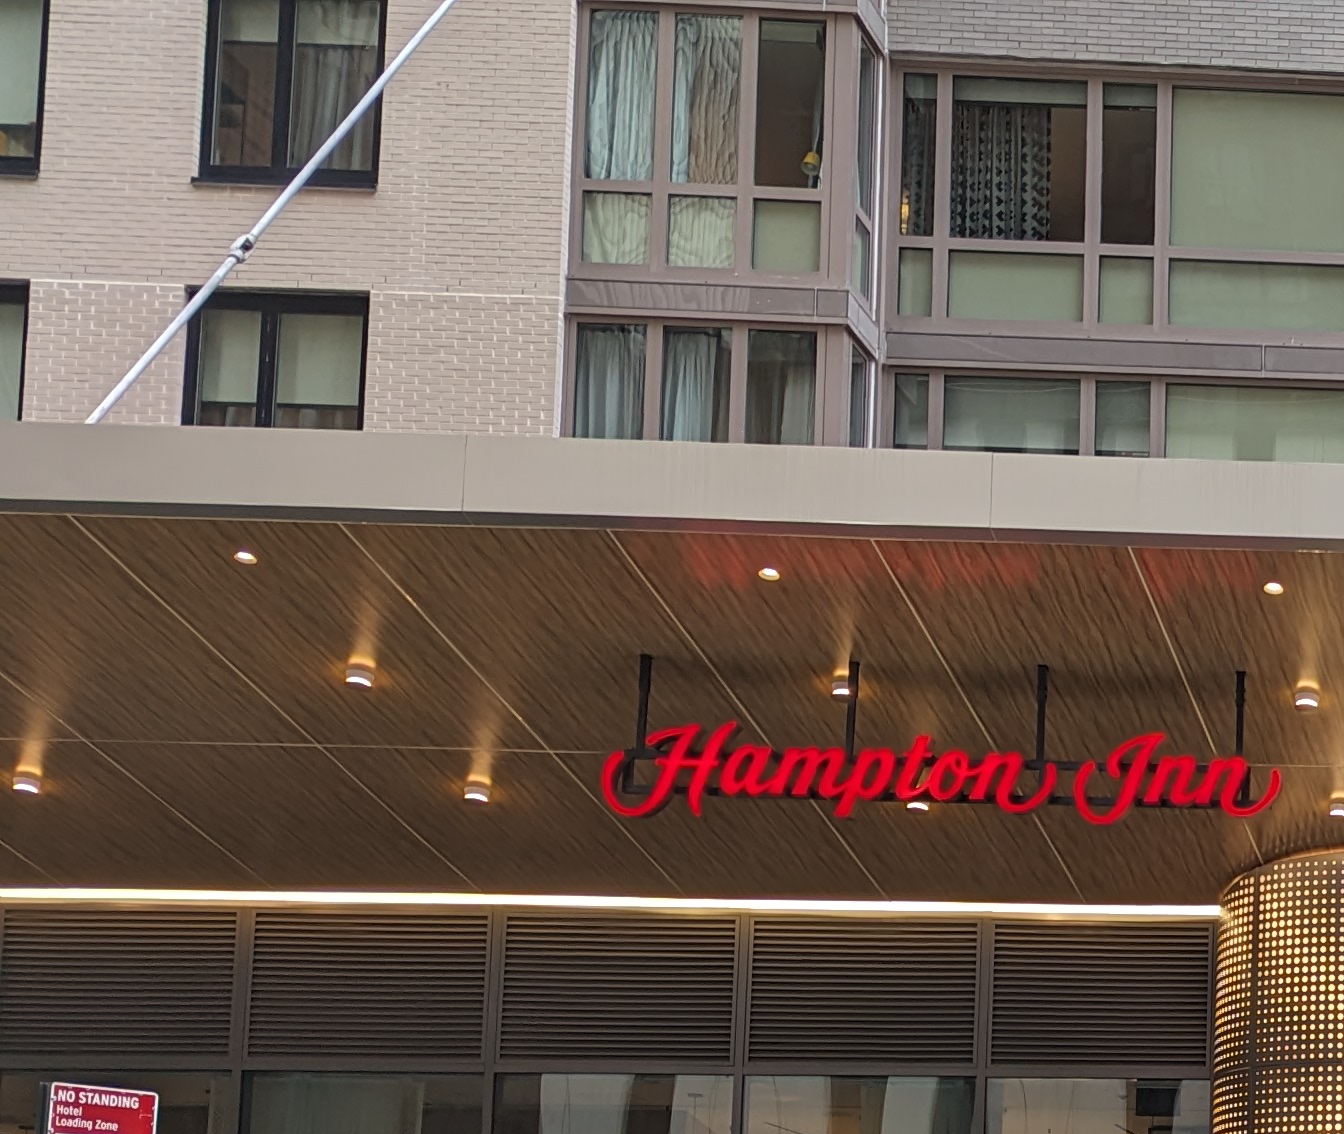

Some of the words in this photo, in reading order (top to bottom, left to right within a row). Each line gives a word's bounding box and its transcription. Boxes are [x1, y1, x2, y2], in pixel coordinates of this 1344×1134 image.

[601, 721, 1057, 817] Hampton
[1074, 733, 1281, 825] Inn
[57, 1089, 76, 1104] NO
[79, 1092, 139, 1109] STANDING
[56, 1104, 83, 1117] Hotel
[56, 1116, 92, 1131] Loading
[95, 1120, 118, 1131] Zone
